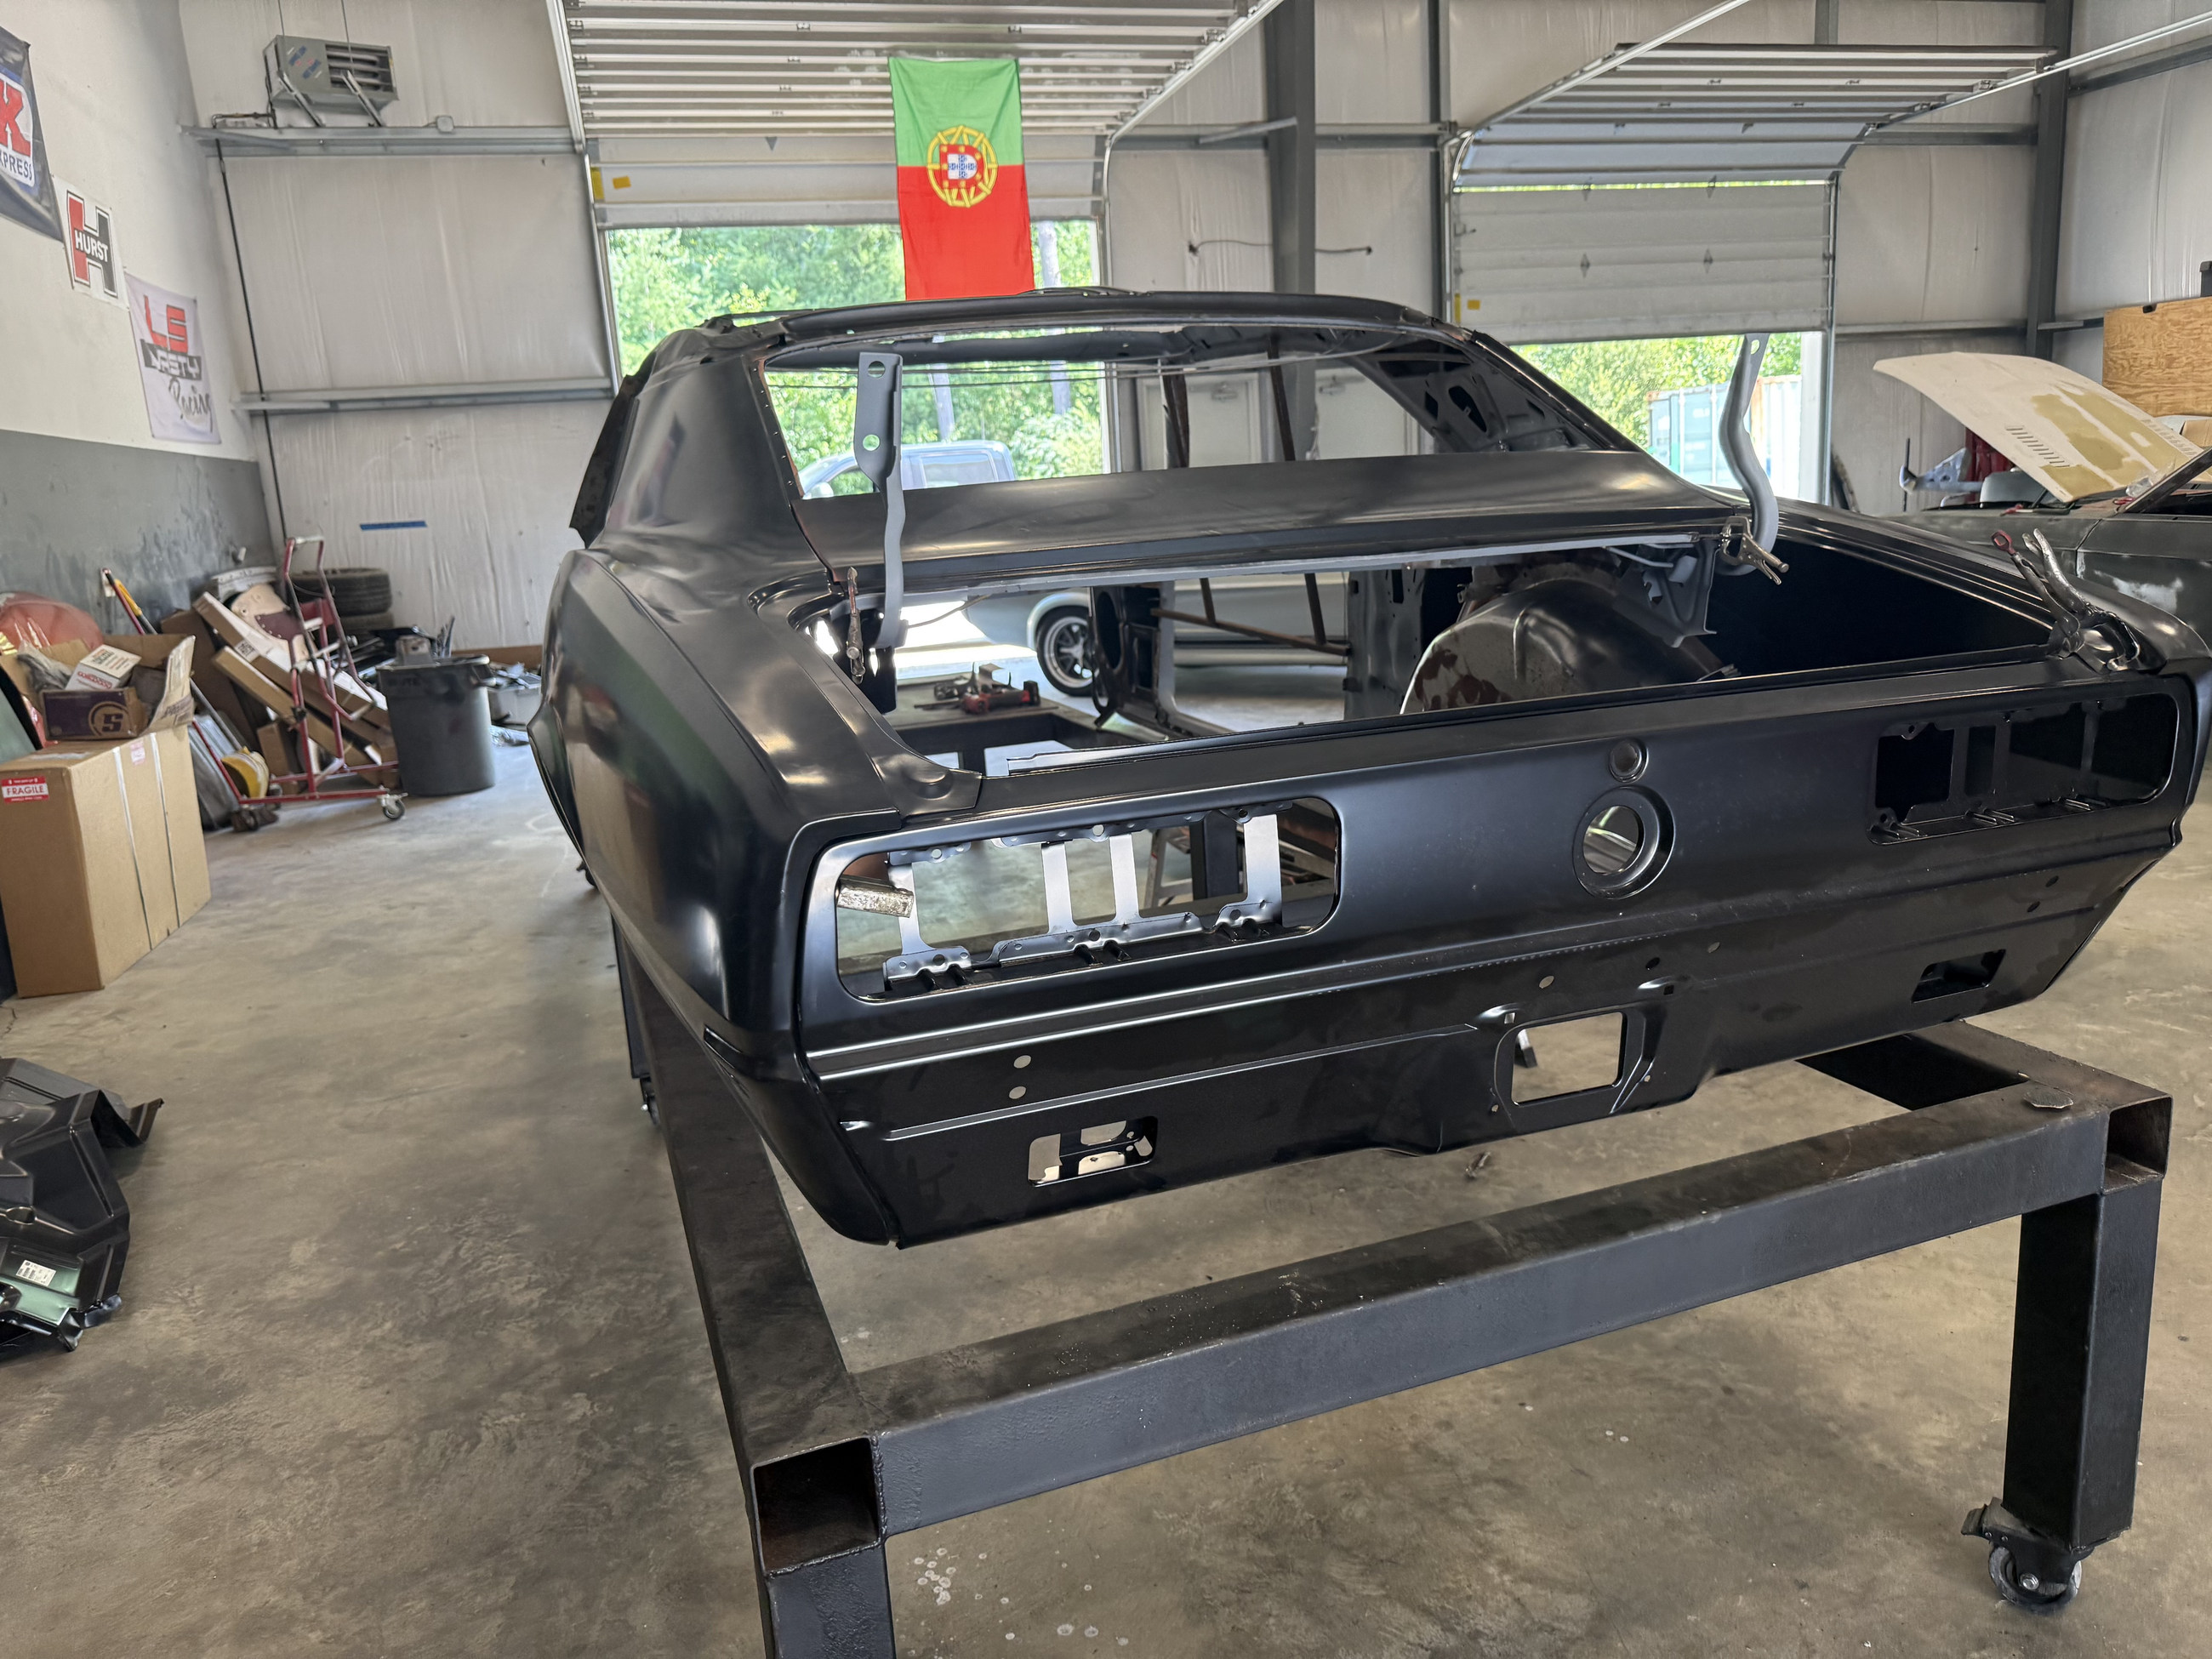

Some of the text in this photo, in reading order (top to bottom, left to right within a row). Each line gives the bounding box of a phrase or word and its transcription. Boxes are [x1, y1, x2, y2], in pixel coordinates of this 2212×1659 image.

[74, 229, 109, 263] HURST
[145, 343, 201, 379] NASTY
[7, 785, 43, 795] FRAGILE
